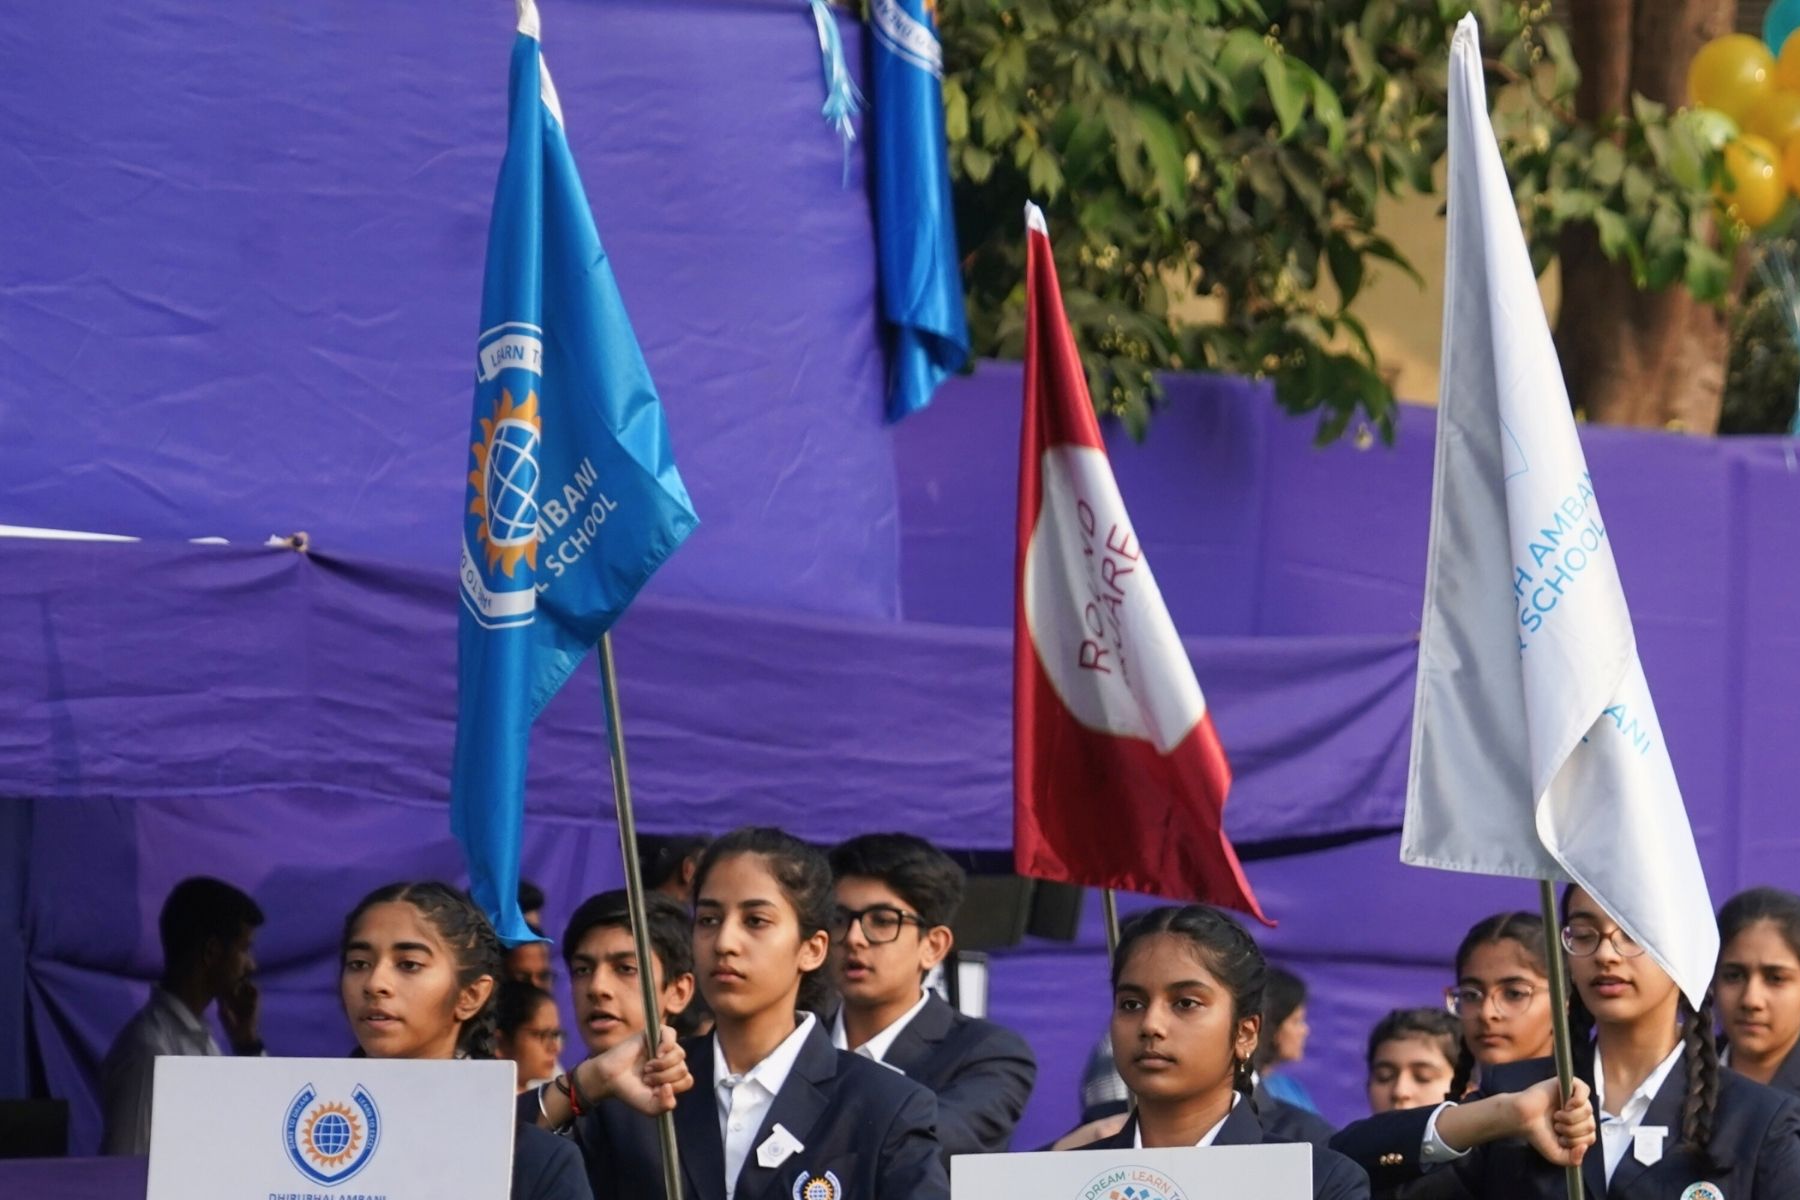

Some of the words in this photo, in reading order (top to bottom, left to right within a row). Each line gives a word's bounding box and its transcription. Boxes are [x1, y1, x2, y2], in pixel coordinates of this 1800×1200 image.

[536, 457, 598, 544] MBANI
[545, 493, 618, 577] SCHOOL
[1520, 518, 1605, 633] SCHOOL
[1085, 1171, 1126, 1200] DREAM
[1132, 1170, 1172, 1194] LEARN
